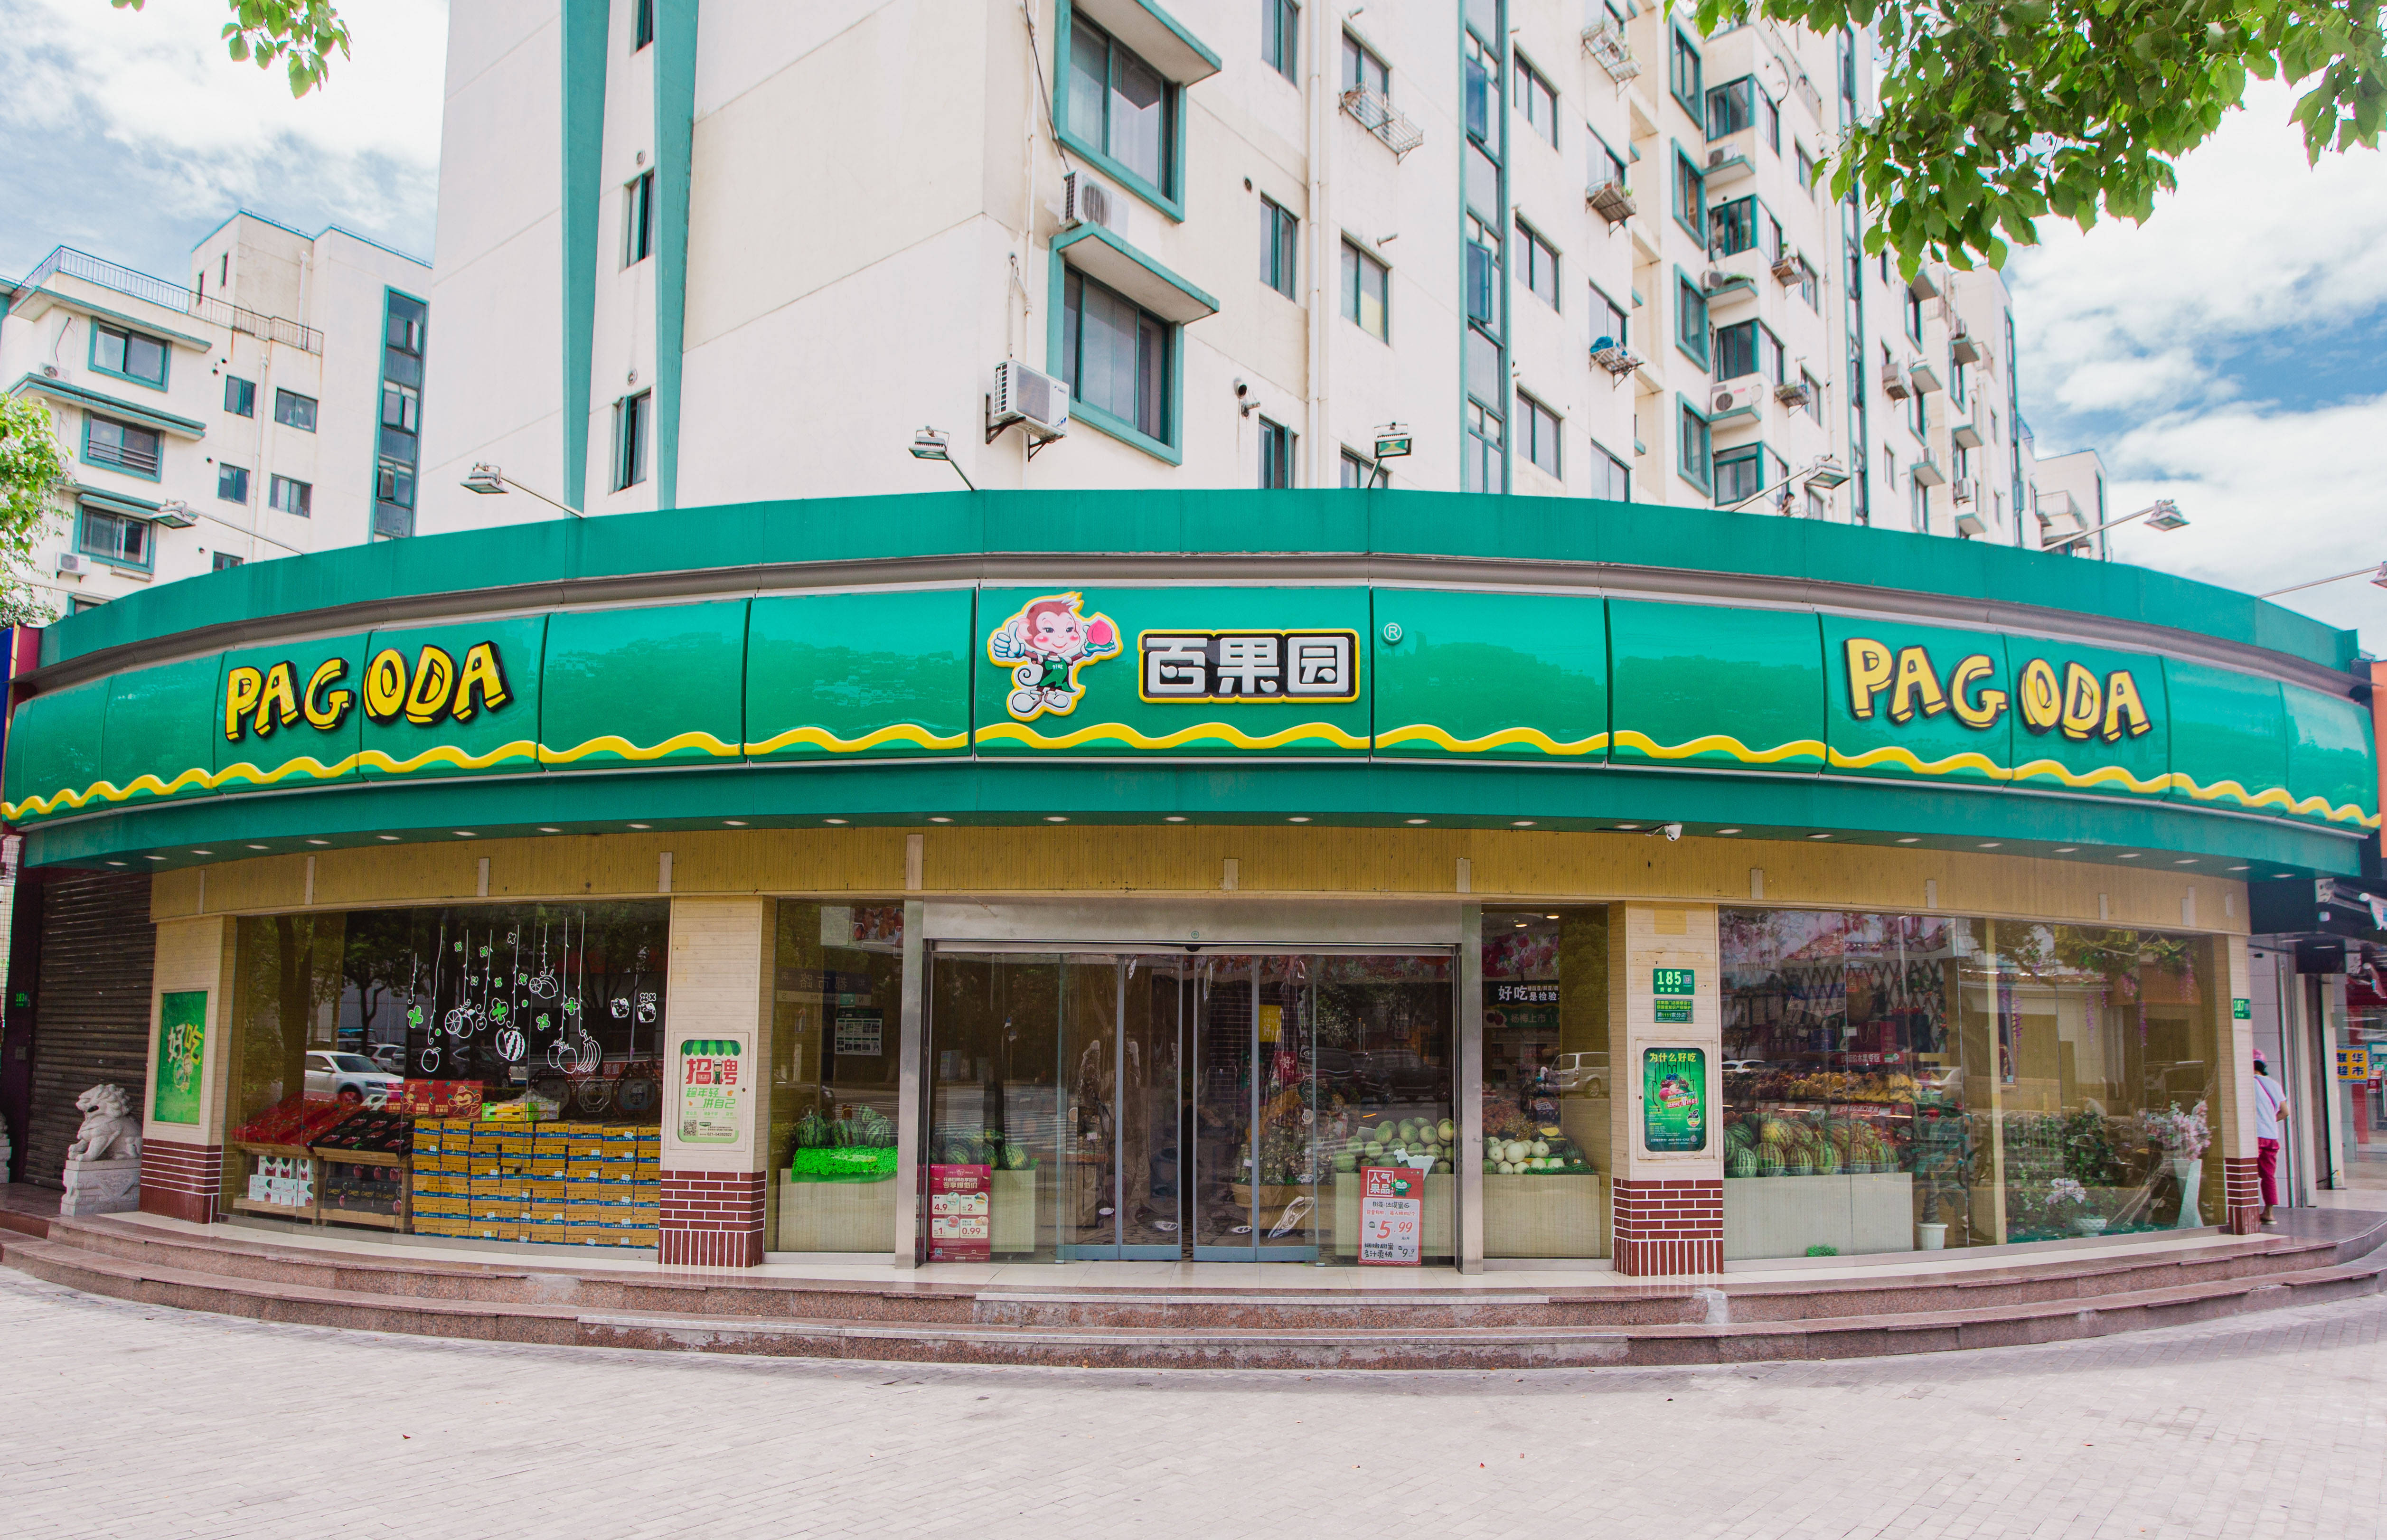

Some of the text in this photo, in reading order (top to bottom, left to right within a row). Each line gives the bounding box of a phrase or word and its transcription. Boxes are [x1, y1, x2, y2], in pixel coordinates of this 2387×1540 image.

[1145, 637, 1349, 694] 百果园
[226, 640, 513, 742] PAGODA
[1843, 637, 2152, 744] PAGODA
[1657, 971, 1682, 985] 185
[1498, 985, 1528, 1001] 好吃
[1529, 992, 1560, 1001] 是检验
[168, 1023, 203, 1065] 好吃
[1649, 1052, 1696, 1062] 为什么好吃
[686, 1058, 738, 1085] 招聘
[2337, 1066, 2364, 1076] 超市
[703, 1098, 736, 1109] 拼自己
[1370, 1172, 1391, 1183] 人气
[1370, 1183, 1391, 1194] 果品
[1377, 1220, 1413, 1239] 5.99
